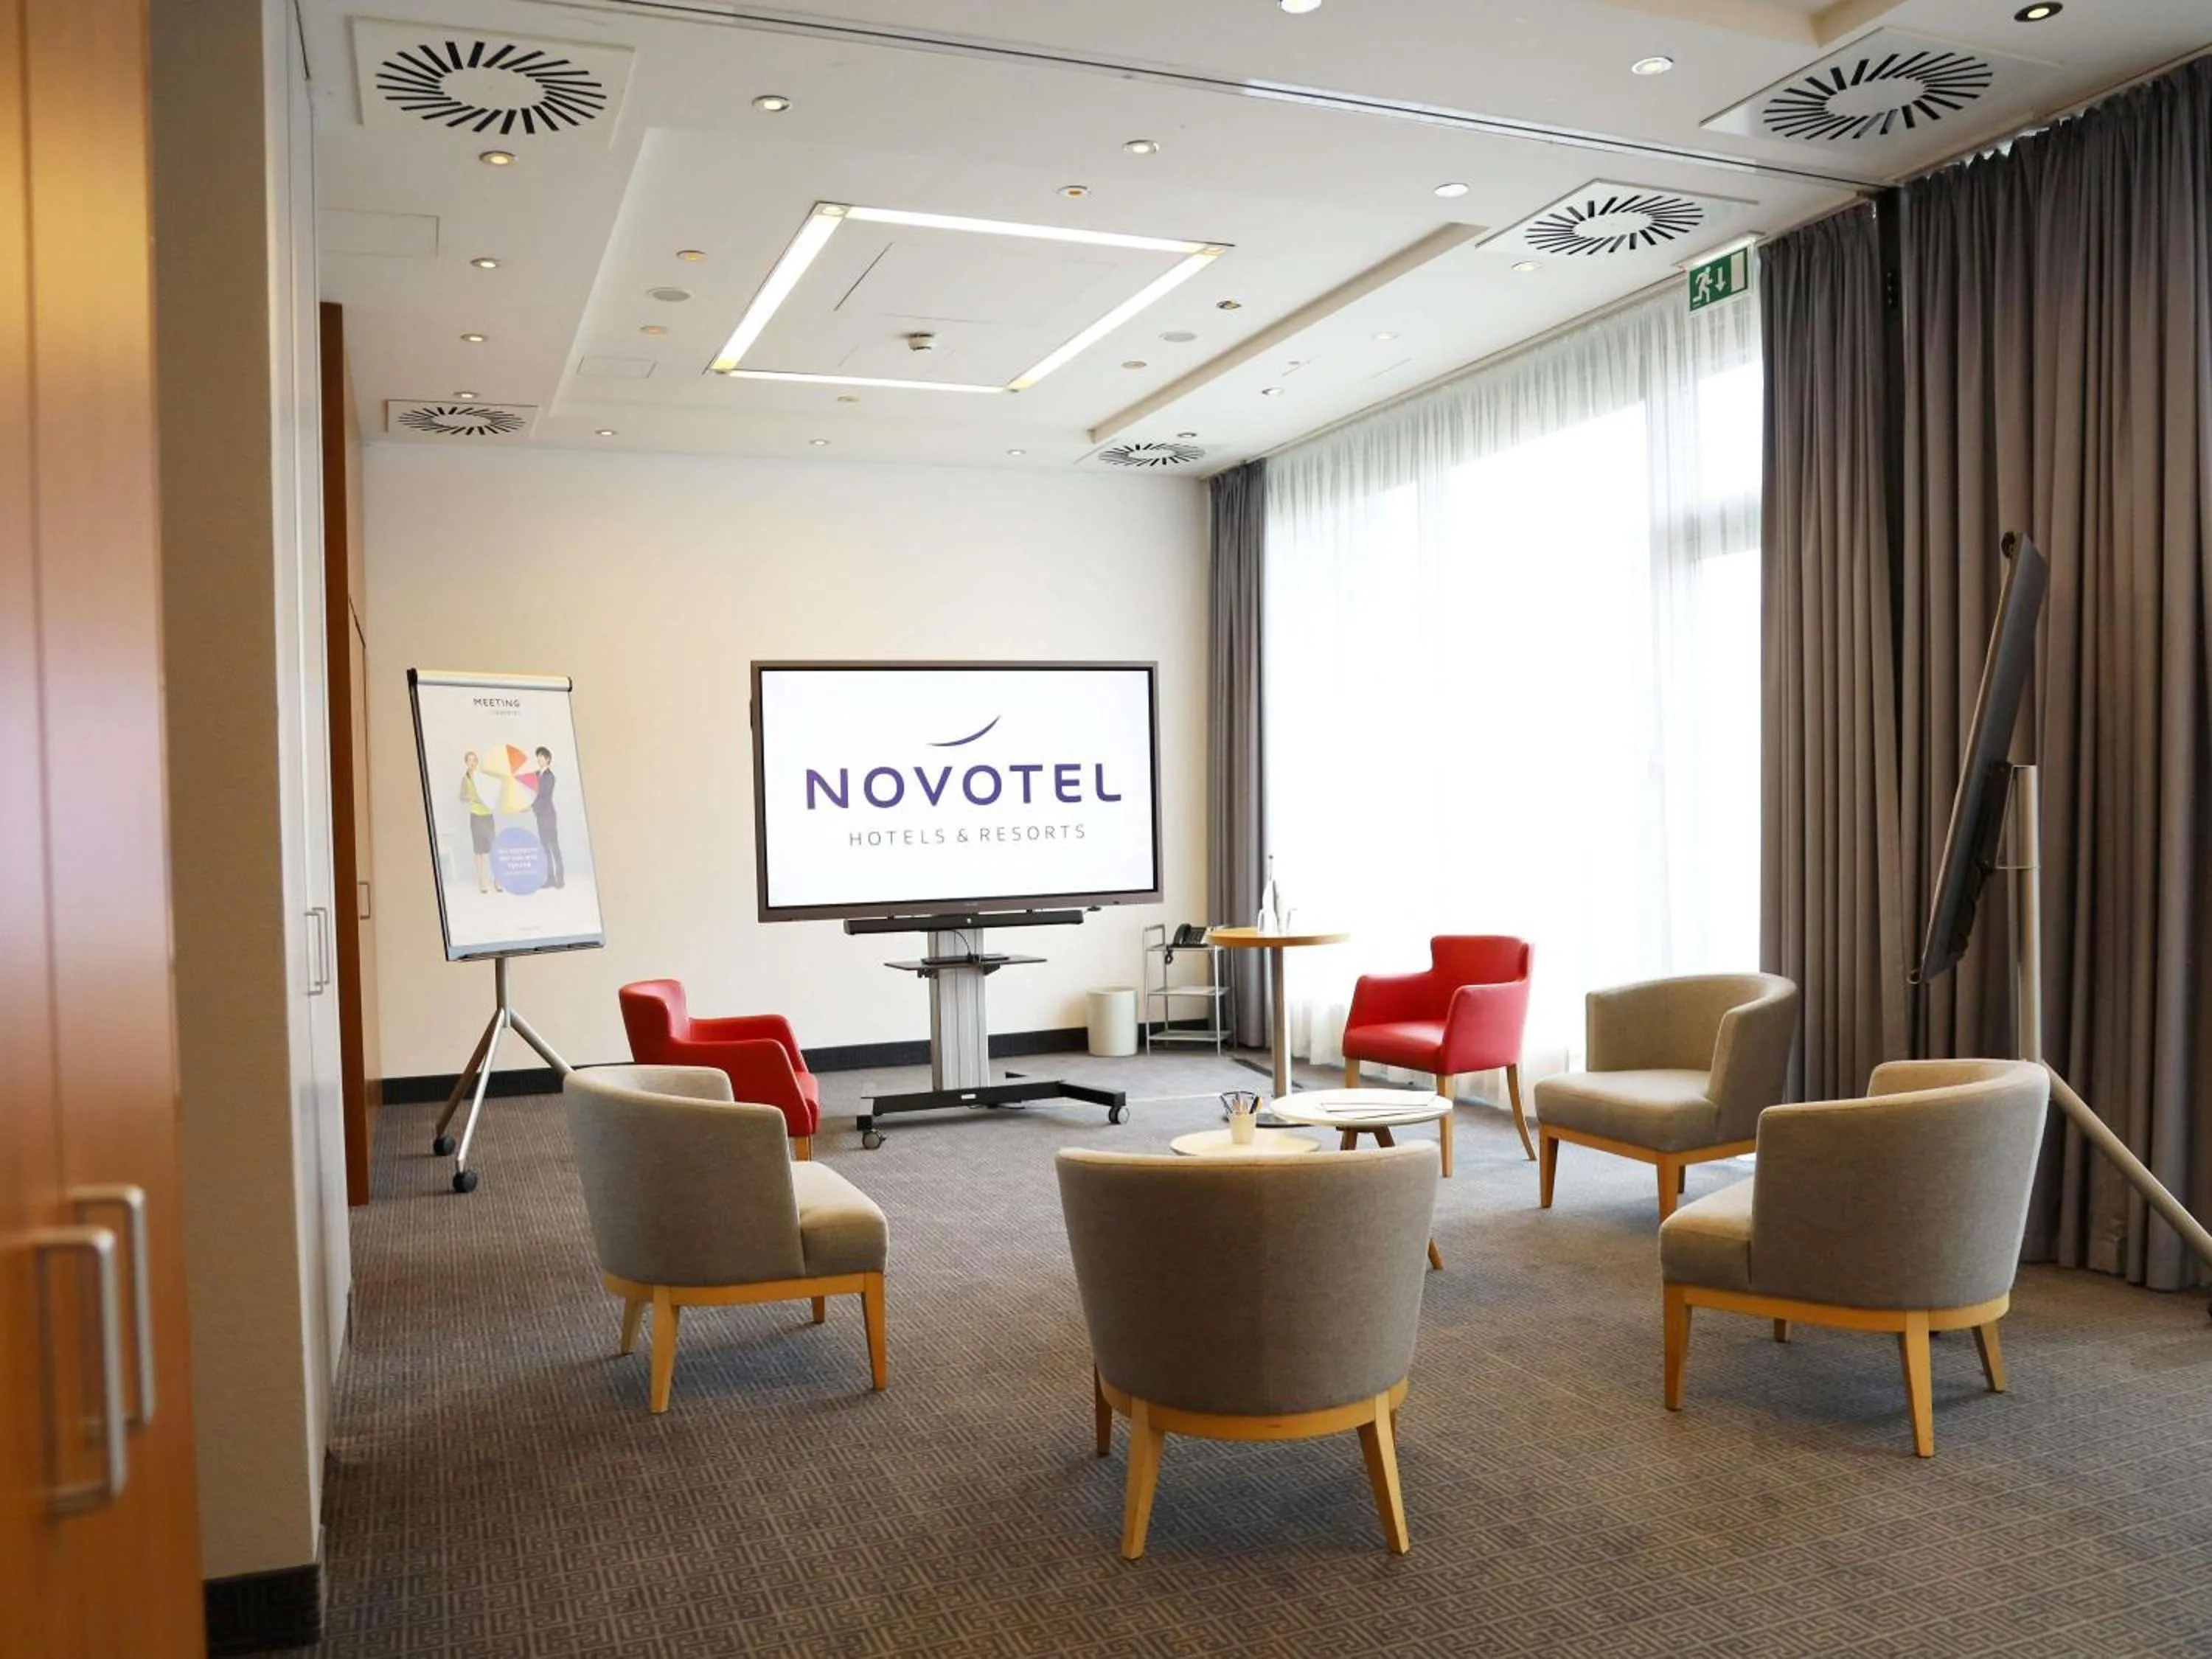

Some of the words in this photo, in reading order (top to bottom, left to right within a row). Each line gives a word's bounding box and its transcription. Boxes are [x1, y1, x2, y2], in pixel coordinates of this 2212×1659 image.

[473, 698, 521, 708] MEETING
[806, 762, 1122, 810] NOVOTEL
[848, 829, 945, 847] HOTELS
[956, 827, 970, 843] &
[979, 824, 1086, 842] RESORTS
